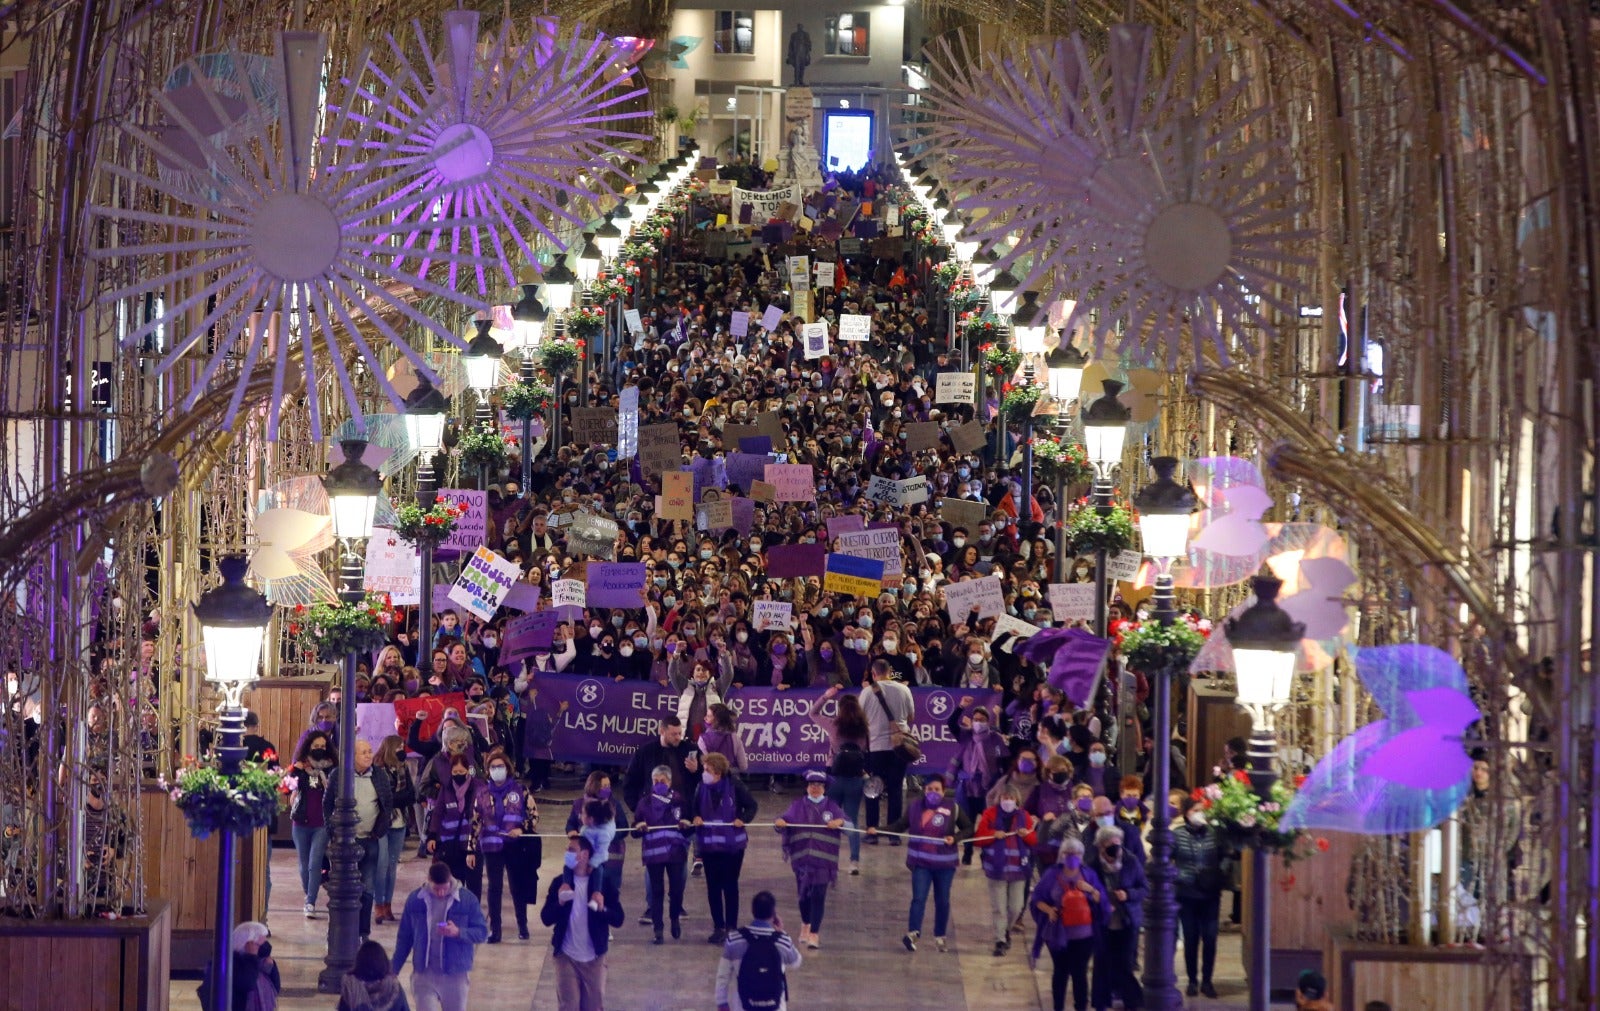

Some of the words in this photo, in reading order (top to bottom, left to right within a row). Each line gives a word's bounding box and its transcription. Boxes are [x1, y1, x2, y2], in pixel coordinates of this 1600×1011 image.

[740, 189, 792, 201] DERECHOS
[446, 493, 483, 507] PORNO
[841, 534, 870, 548] NUESTRO
[873, 531, 898, 545] CUERPO
[471, 556, 512, 590] MUJER
[457, 576, 498, 608] MORIR
[758, 611, 772, 619] NO
[632, 691, 652, 711] EL
[749, 698, 768, 717] ES
[564, 711, 598, 731] LAS
[602, 714, 662, 737] MUJER
[796, 752, 810, 763] de
